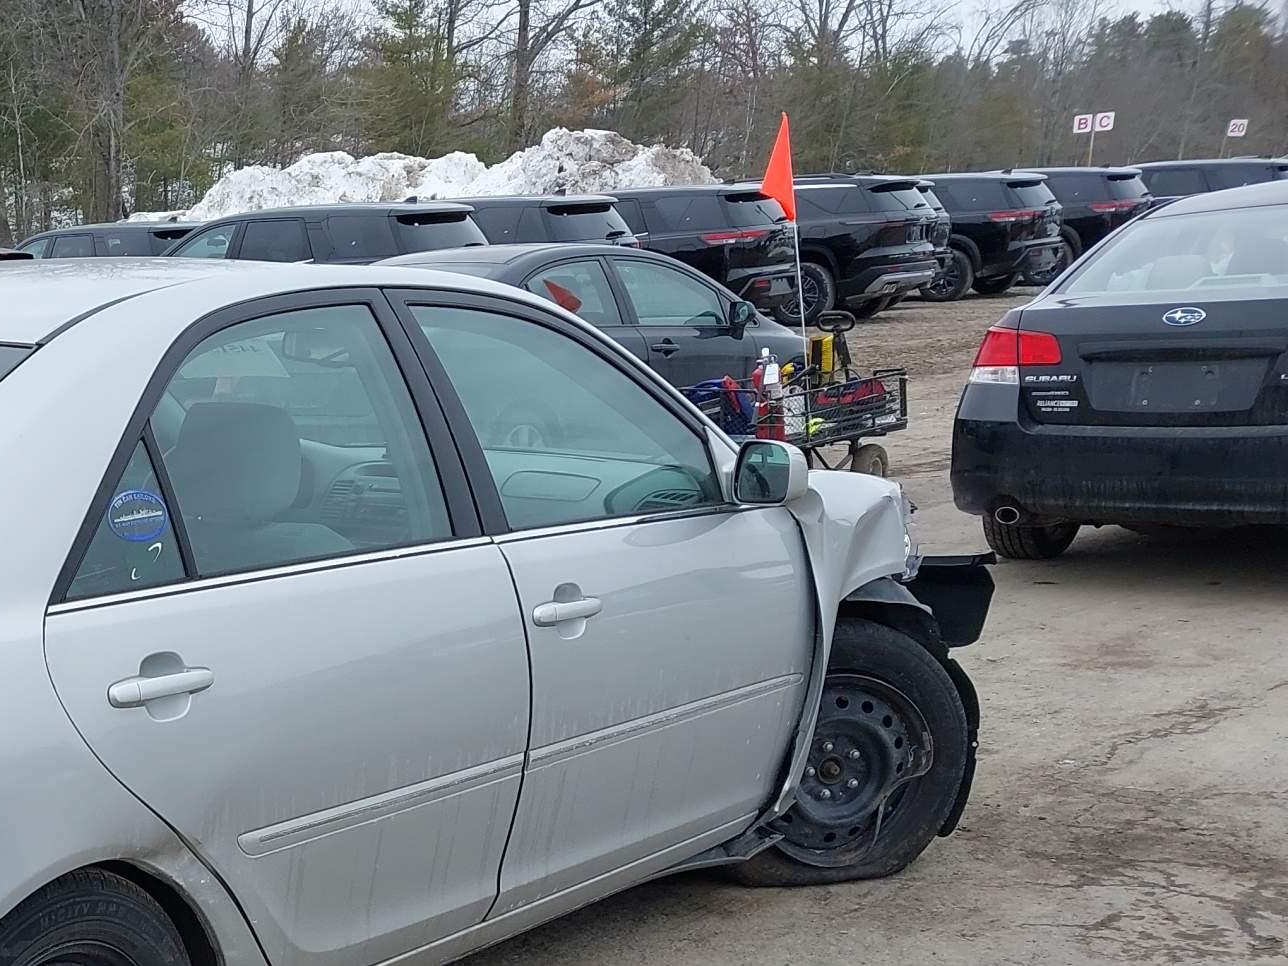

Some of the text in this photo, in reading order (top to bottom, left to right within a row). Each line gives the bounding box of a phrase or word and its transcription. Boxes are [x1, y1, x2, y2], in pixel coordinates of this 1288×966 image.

[1077, 117, 1088, 130] B
[1099, 115, 1111, 128] C
[1230, 122, 1245, 133] 20
[1024, 375, 1077, 383] SUBARU
